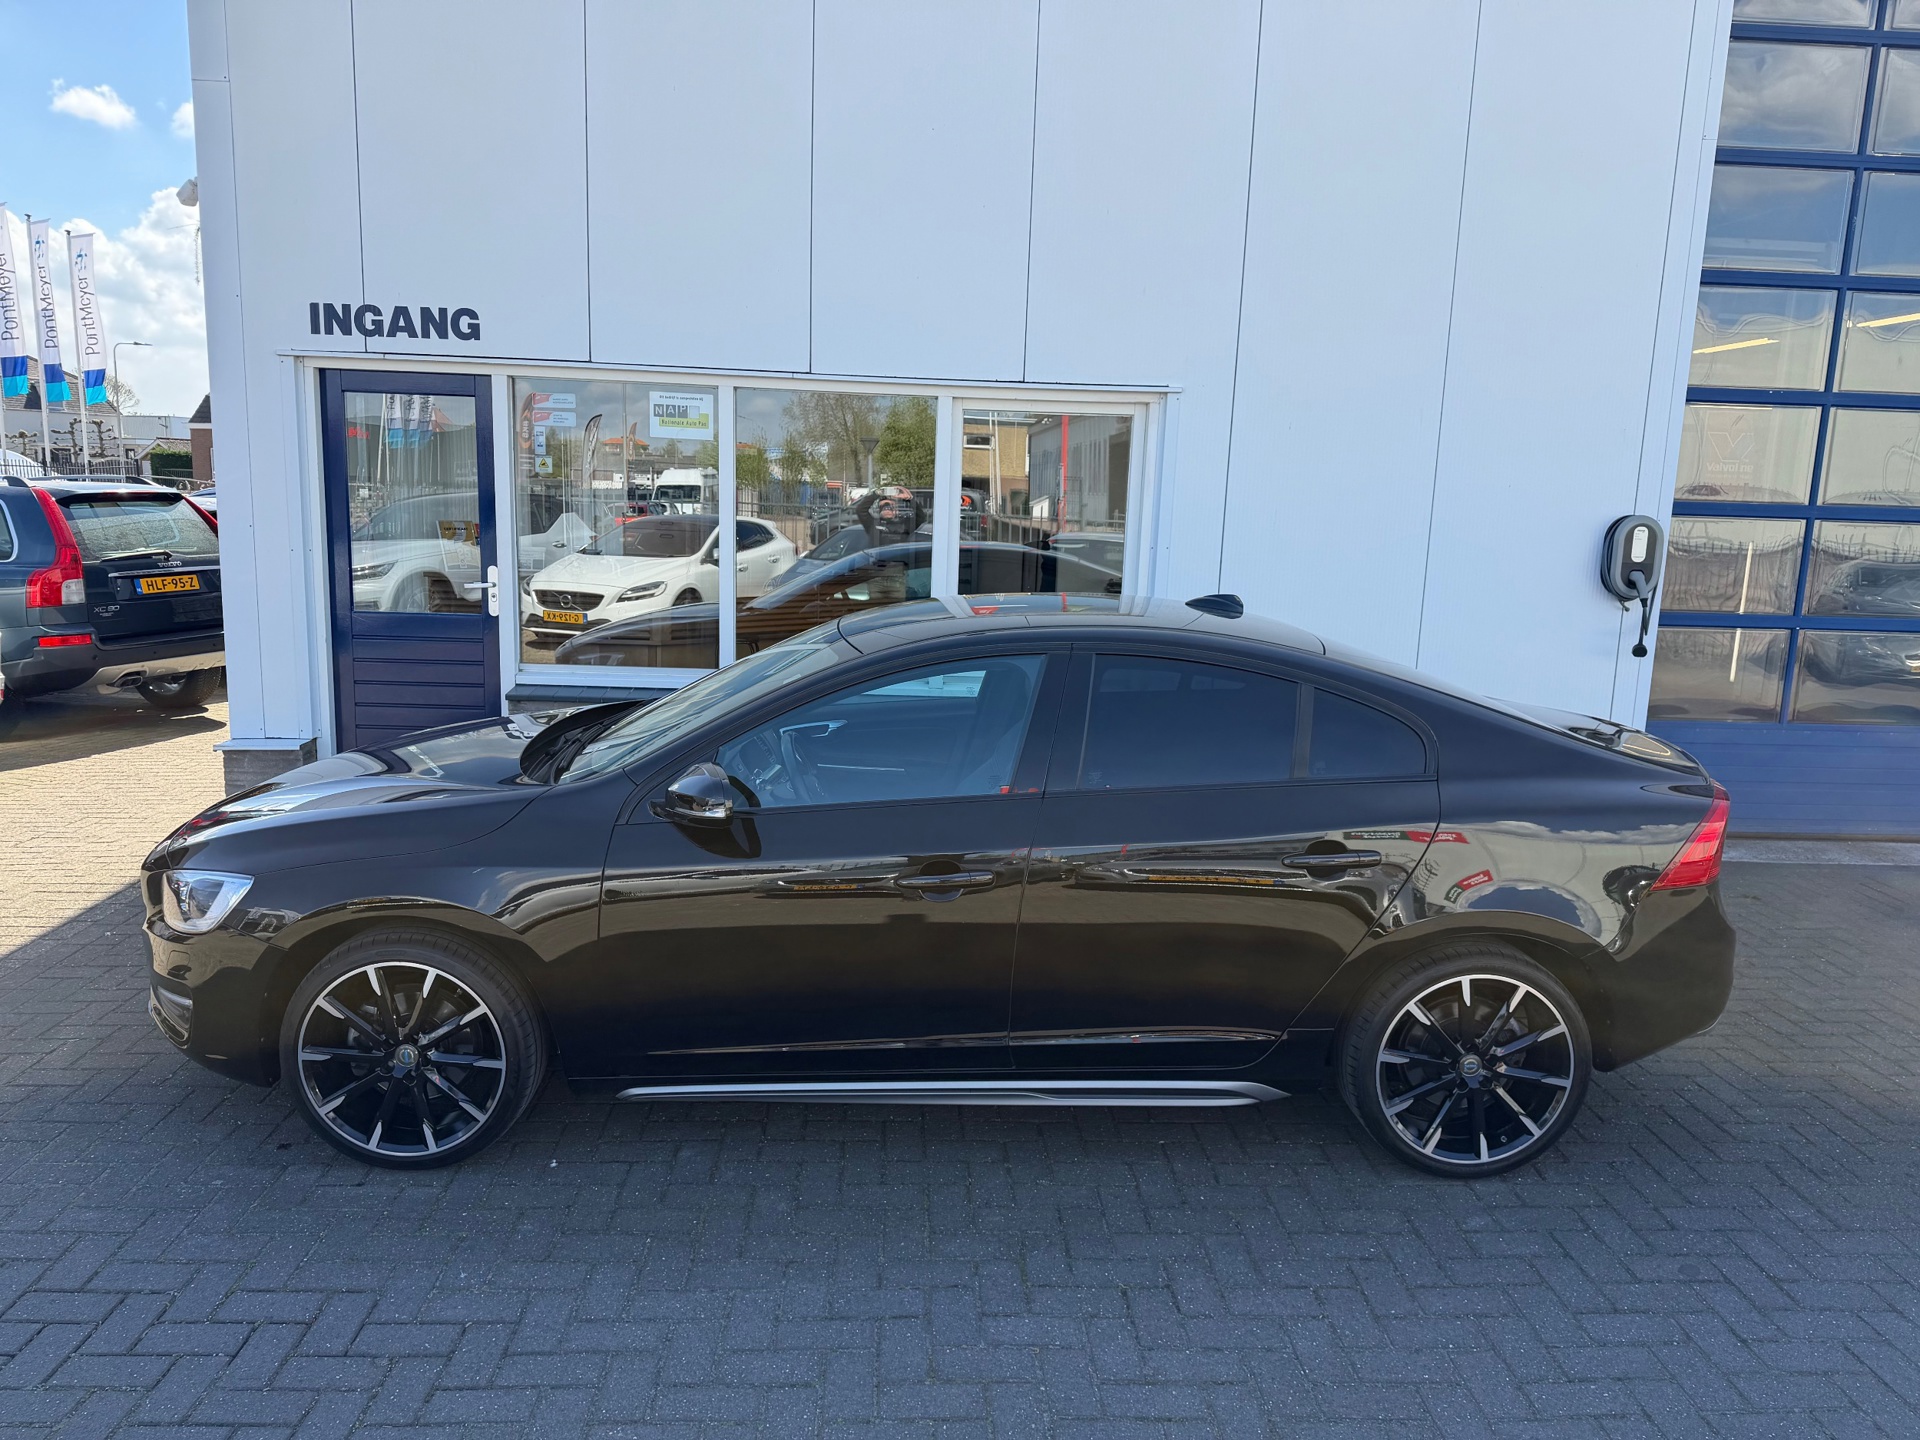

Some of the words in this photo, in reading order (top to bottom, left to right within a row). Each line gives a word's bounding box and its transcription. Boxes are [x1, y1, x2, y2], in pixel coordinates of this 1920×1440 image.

[37, 263, 58, 348] PontMeyer
[78, 275, 100, 356] PontMeyer
[309, 302, 481, 341] INGANG
[146, 577, 196, 591] HLF-95-Z
